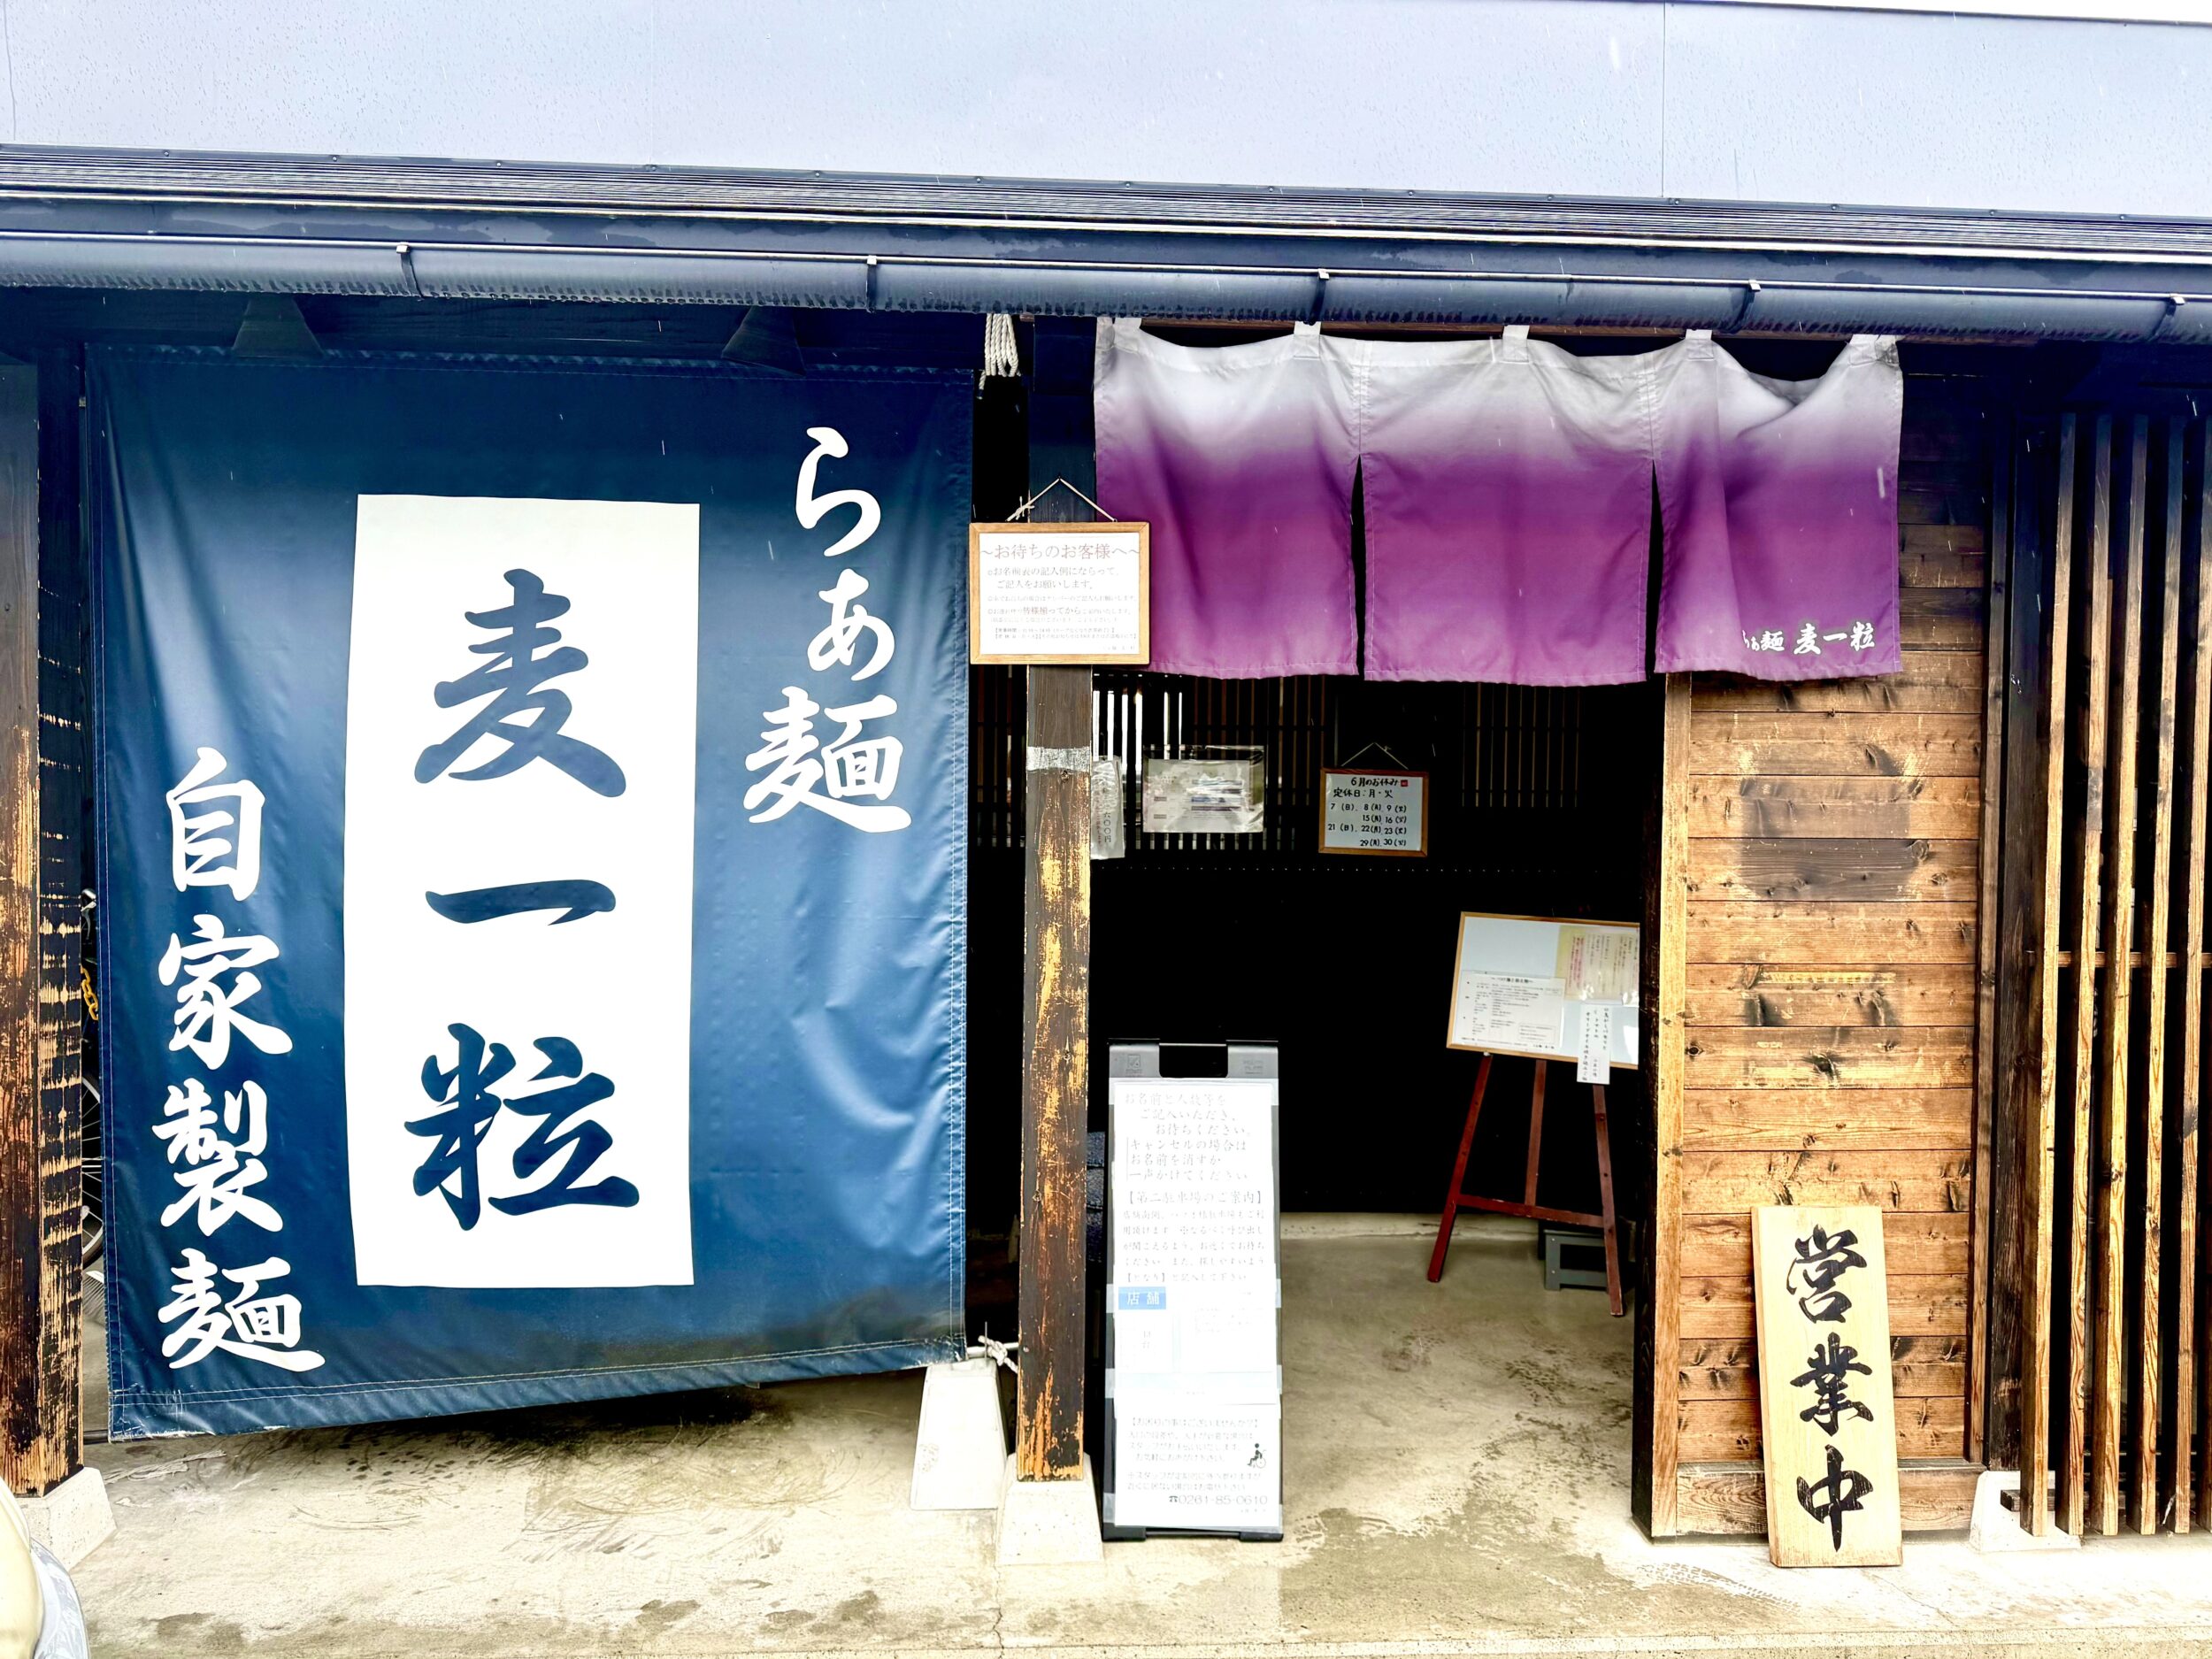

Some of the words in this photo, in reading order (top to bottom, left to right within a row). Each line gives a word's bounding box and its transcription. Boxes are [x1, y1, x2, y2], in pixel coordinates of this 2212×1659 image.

[742, 426, 911, 833] らぁ麺
[1793, 620, 1876, 655] 麦一粒
[151, 747, 326, 1372] 自家製麺
[403, 567, 641, 1232] 麦一粒
[1130, 1139, 1247, 1151] キャンセルの場合は
[1786, 1223, 1875, 1553] 営業中
